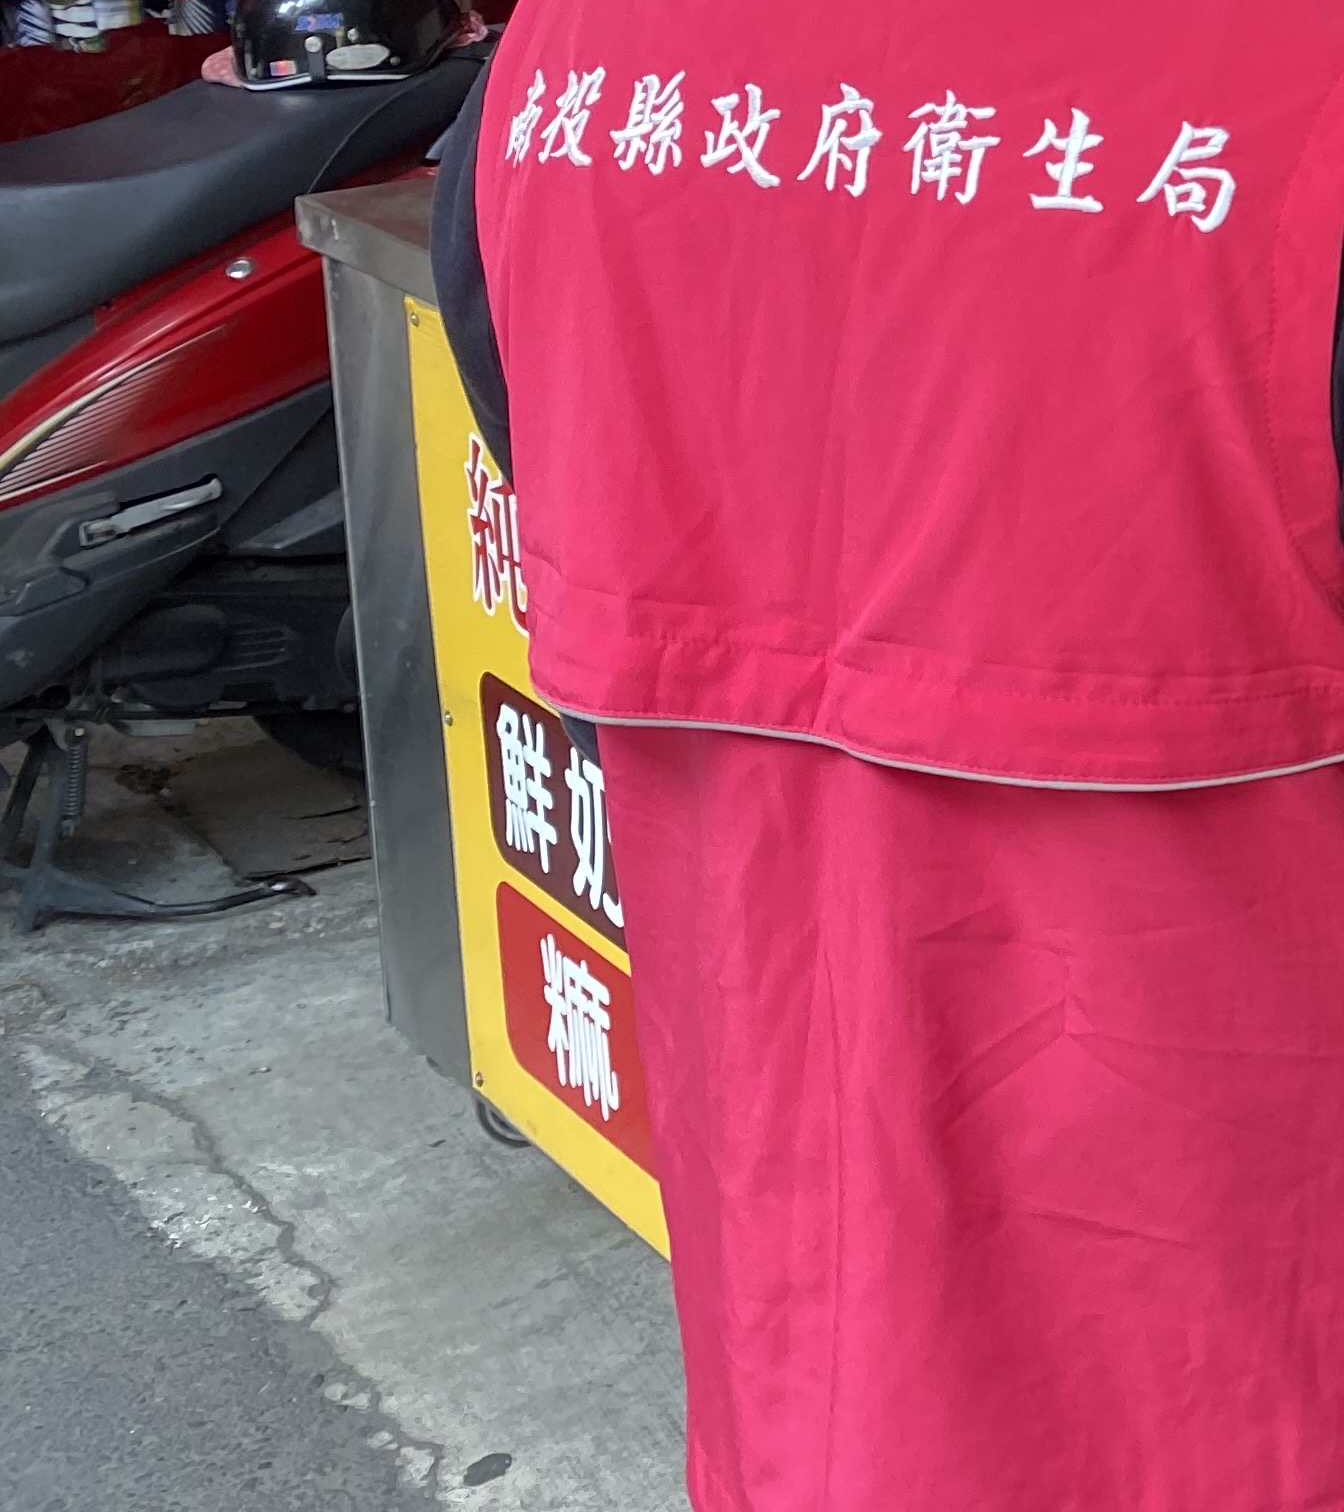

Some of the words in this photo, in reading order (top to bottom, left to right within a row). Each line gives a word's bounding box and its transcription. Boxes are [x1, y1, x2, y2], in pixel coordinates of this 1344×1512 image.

[505, 66, 1236, 234] 南投縣政府衛生局
